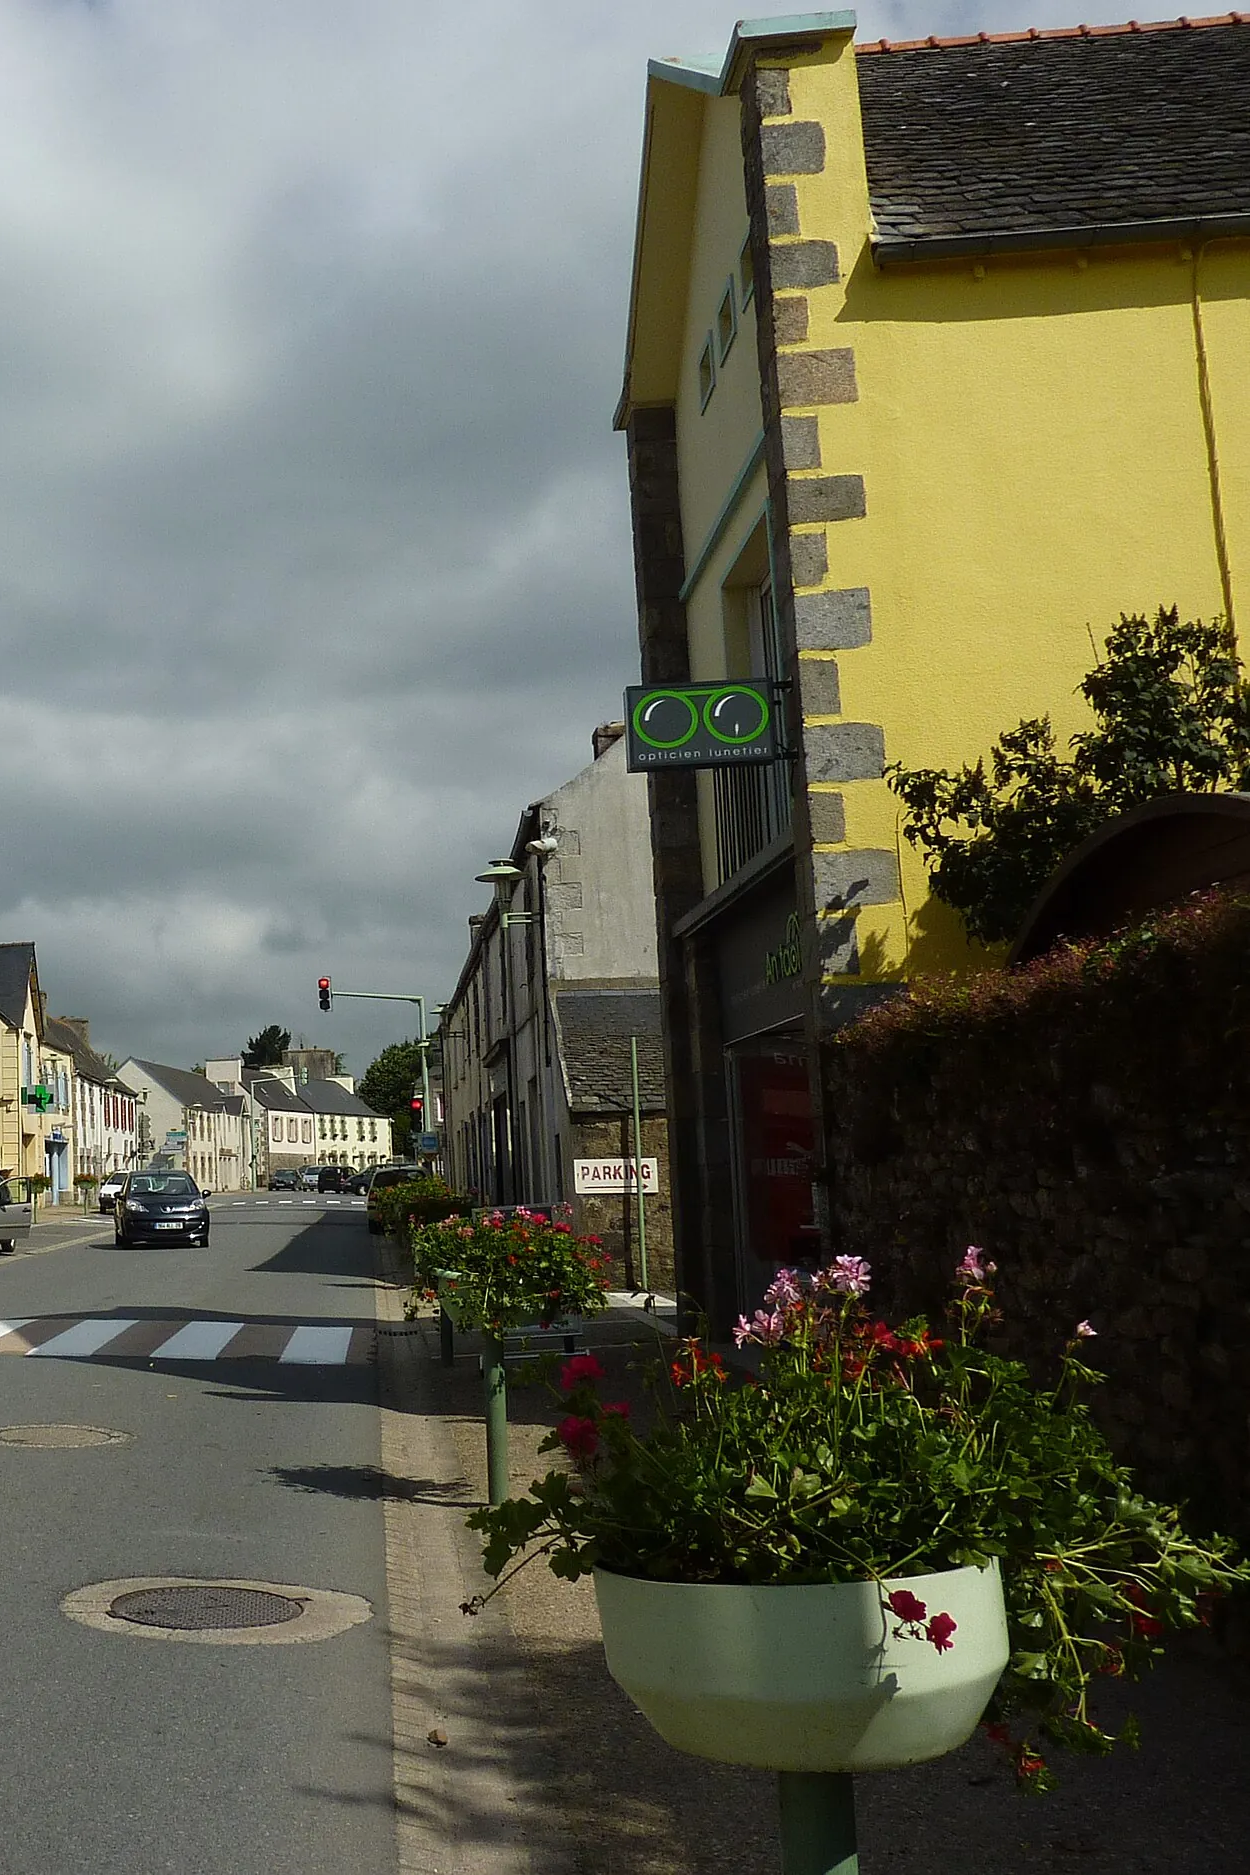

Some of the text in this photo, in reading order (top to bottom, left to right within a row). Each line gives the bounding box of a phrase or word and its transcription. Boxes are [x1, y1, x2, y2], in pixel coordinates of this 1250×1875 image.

[638, 746, 768, 761] opticien lunetier
[581, 1163, 652, 1181] PARKING
